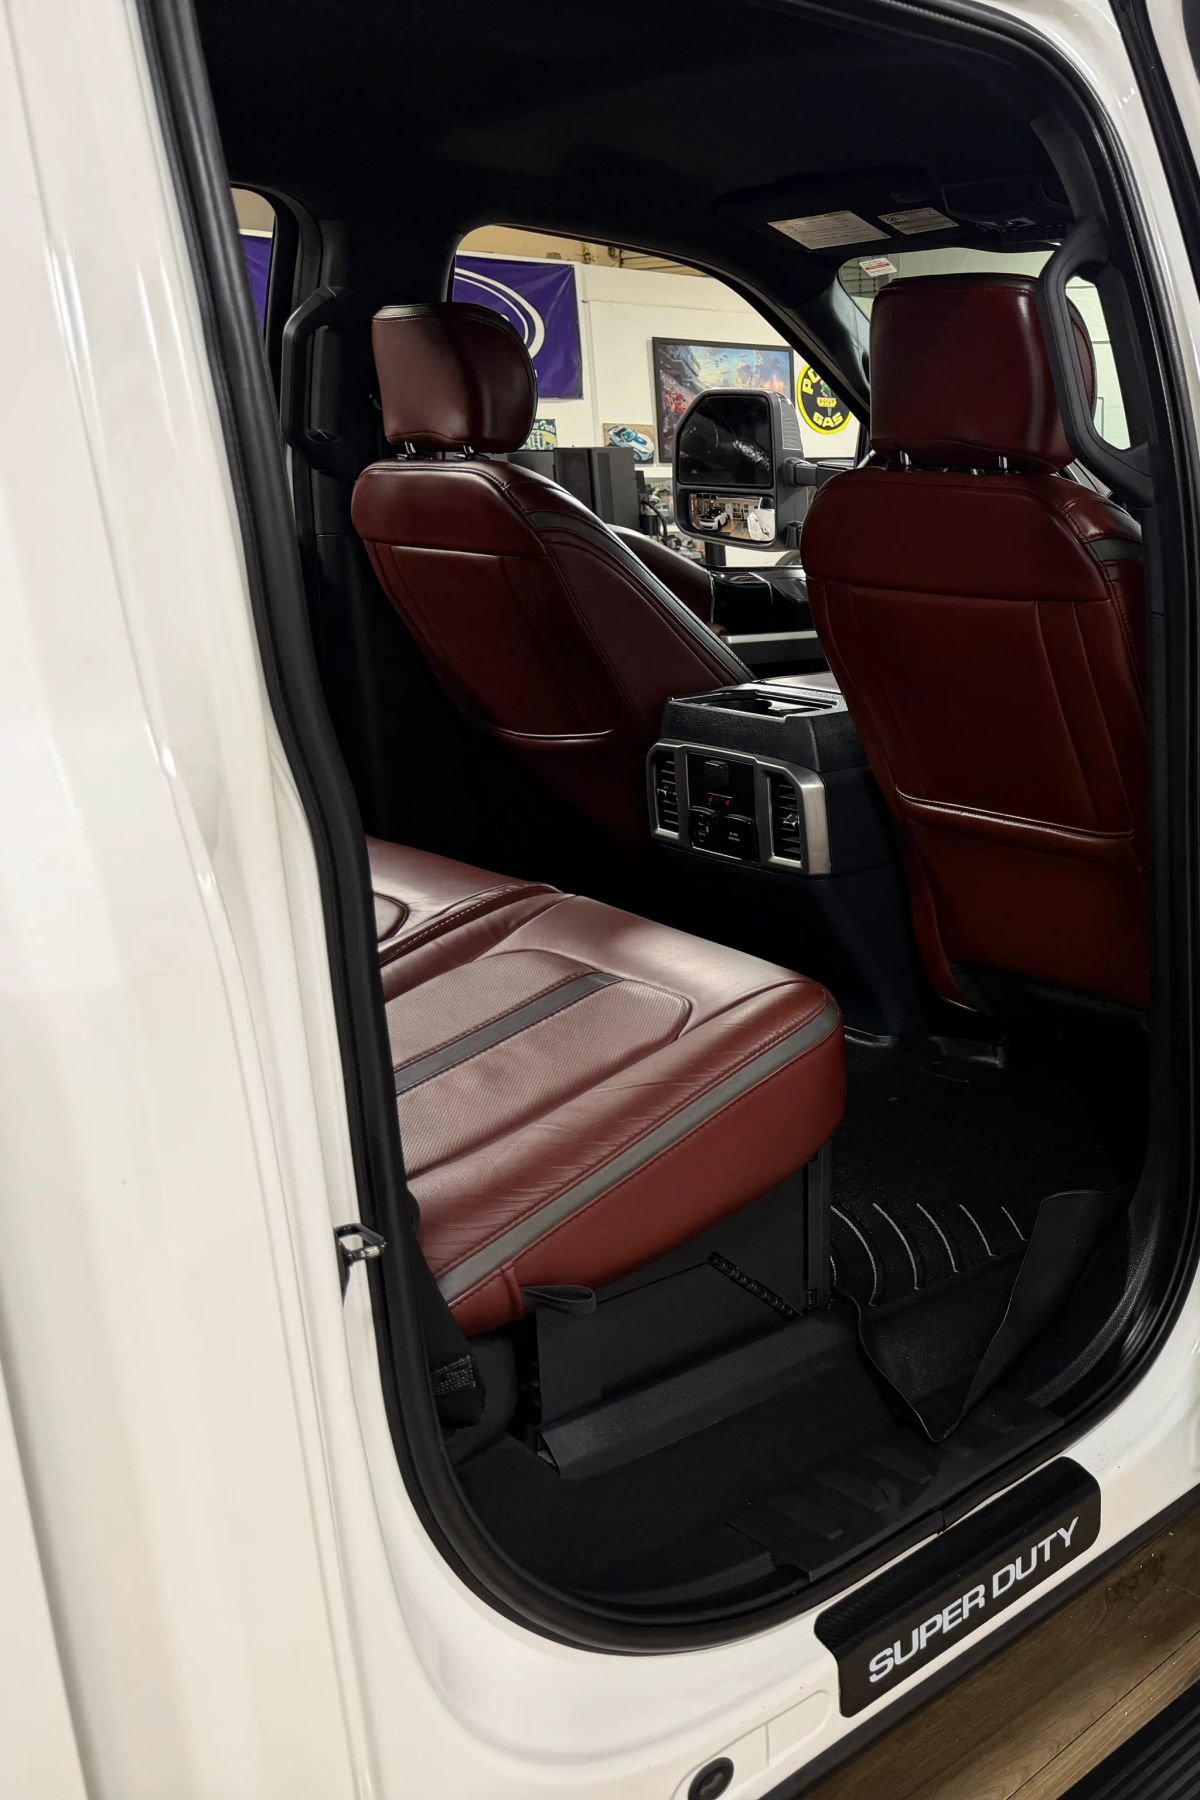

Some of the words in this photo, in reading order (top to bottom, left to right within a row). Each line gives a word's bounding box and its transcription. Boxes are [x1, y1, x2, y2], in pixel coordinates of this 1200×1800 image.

[813, 411, 844, 427] GAS
[869, 1584, 985, 1683] SUPER
[992, 1516, 1079, 1599] DUTY
